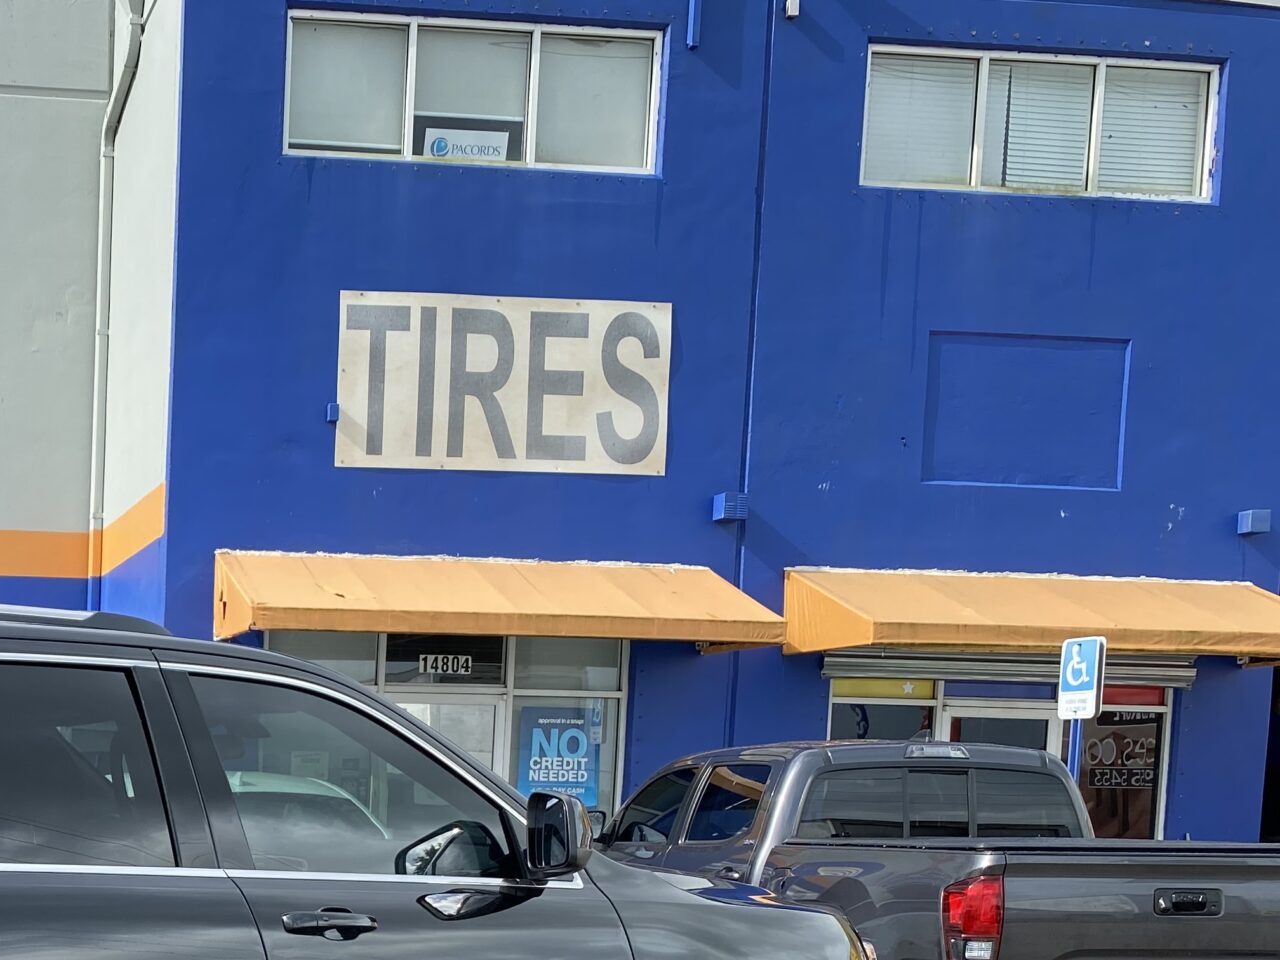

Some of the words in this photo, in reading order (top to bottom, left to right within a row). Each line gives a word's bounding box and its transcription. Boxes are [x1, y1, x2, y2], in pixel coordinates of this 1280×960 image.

[451, 144, 502, 156] PACORDS
[346, 303, 661, 465] TIRES
[420, 655, 472, 673] 14804
[531, 727, 588, 759] NO
[529, 756, 588, 771] CREDIT
[528, 769, 588, 782] NEEDED
